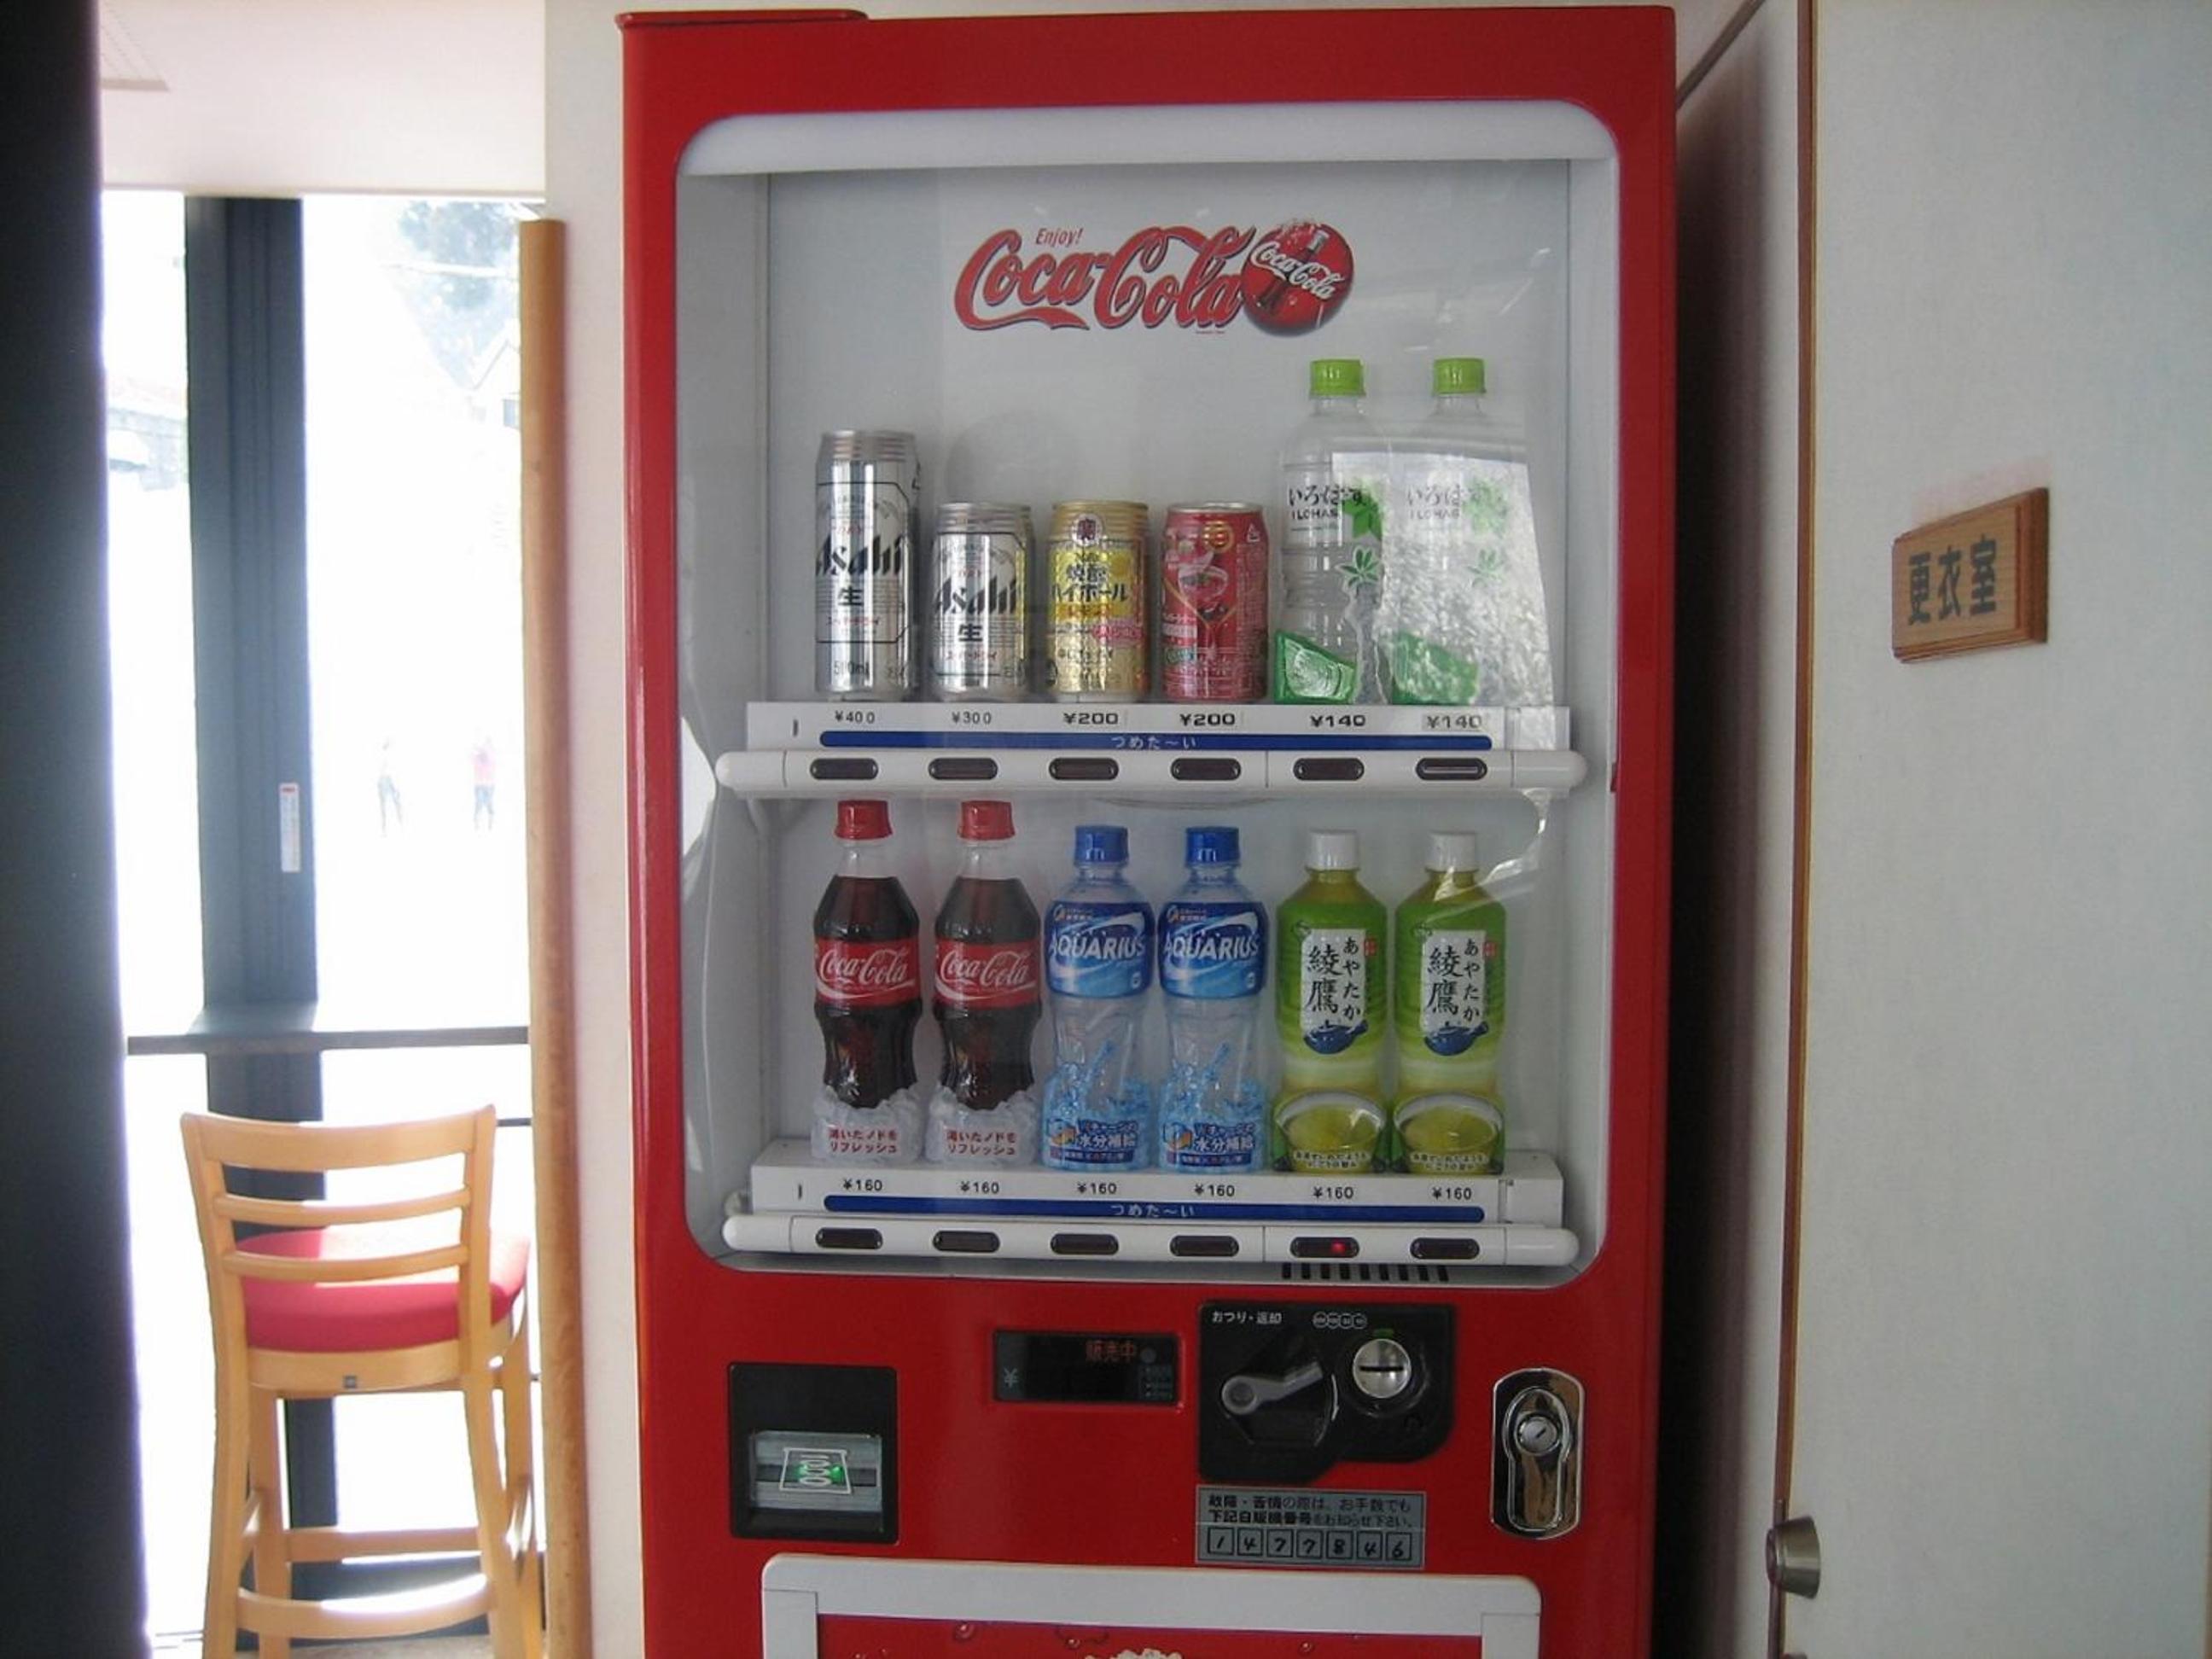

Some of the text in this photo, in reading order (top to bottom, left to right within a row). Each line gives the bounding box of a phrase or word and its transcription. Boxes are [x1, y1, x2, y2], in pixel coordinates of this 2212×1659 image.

[1035, 227, 1083, 247] Enjoy!
[954, 225, 1256, 331] Coca-Cola
[815, 534, 903, 575] Asahi
[1908, 533, 1997, 626] 更衣室
[838, 585, 864, 606] 生
[934, 576, 1017, 614] Asahi
[1051, 583, 1128, 602] ハイボール
[958, 623, 983, 643] 生
[835, 711, 876, 725] ¥400
[952, 711, 992, 725] ¥300
[1063, 712, 1120, 725] ¥200
[1180, 713, 1236, 726] ¥200
[1310, 714, 1365, 727] ¥140
[1426, 714, 1482, 728] ¥140
[1049, 930, 1145, 960] AQUARIUS
[1163, 930, 1259, 960] AQUARIUS
[1306, 943, 1343, 1013] 綾鷹
[1342, 936, 1362, 1022] あやたか
[1427, 944, 1464, 1015] 綾鷹
[1463, 938, 1481, 1022] あやたか
[830, 1142, 897, 1154] リフレッシュ
[948, 1144, 1016, 1156] リフレッシュ
[843, 1179, 882, 1191] ¥160
[961, 1181, 999, 1193] ¥160
[1077, 1182, 1117, 1194] ¥160
[1195, 1185, 1235, 1196] ¥160
[1313, 1186, 1354, 1199] ¥160
[1432, 1187, 1472, 1200] ¥160
